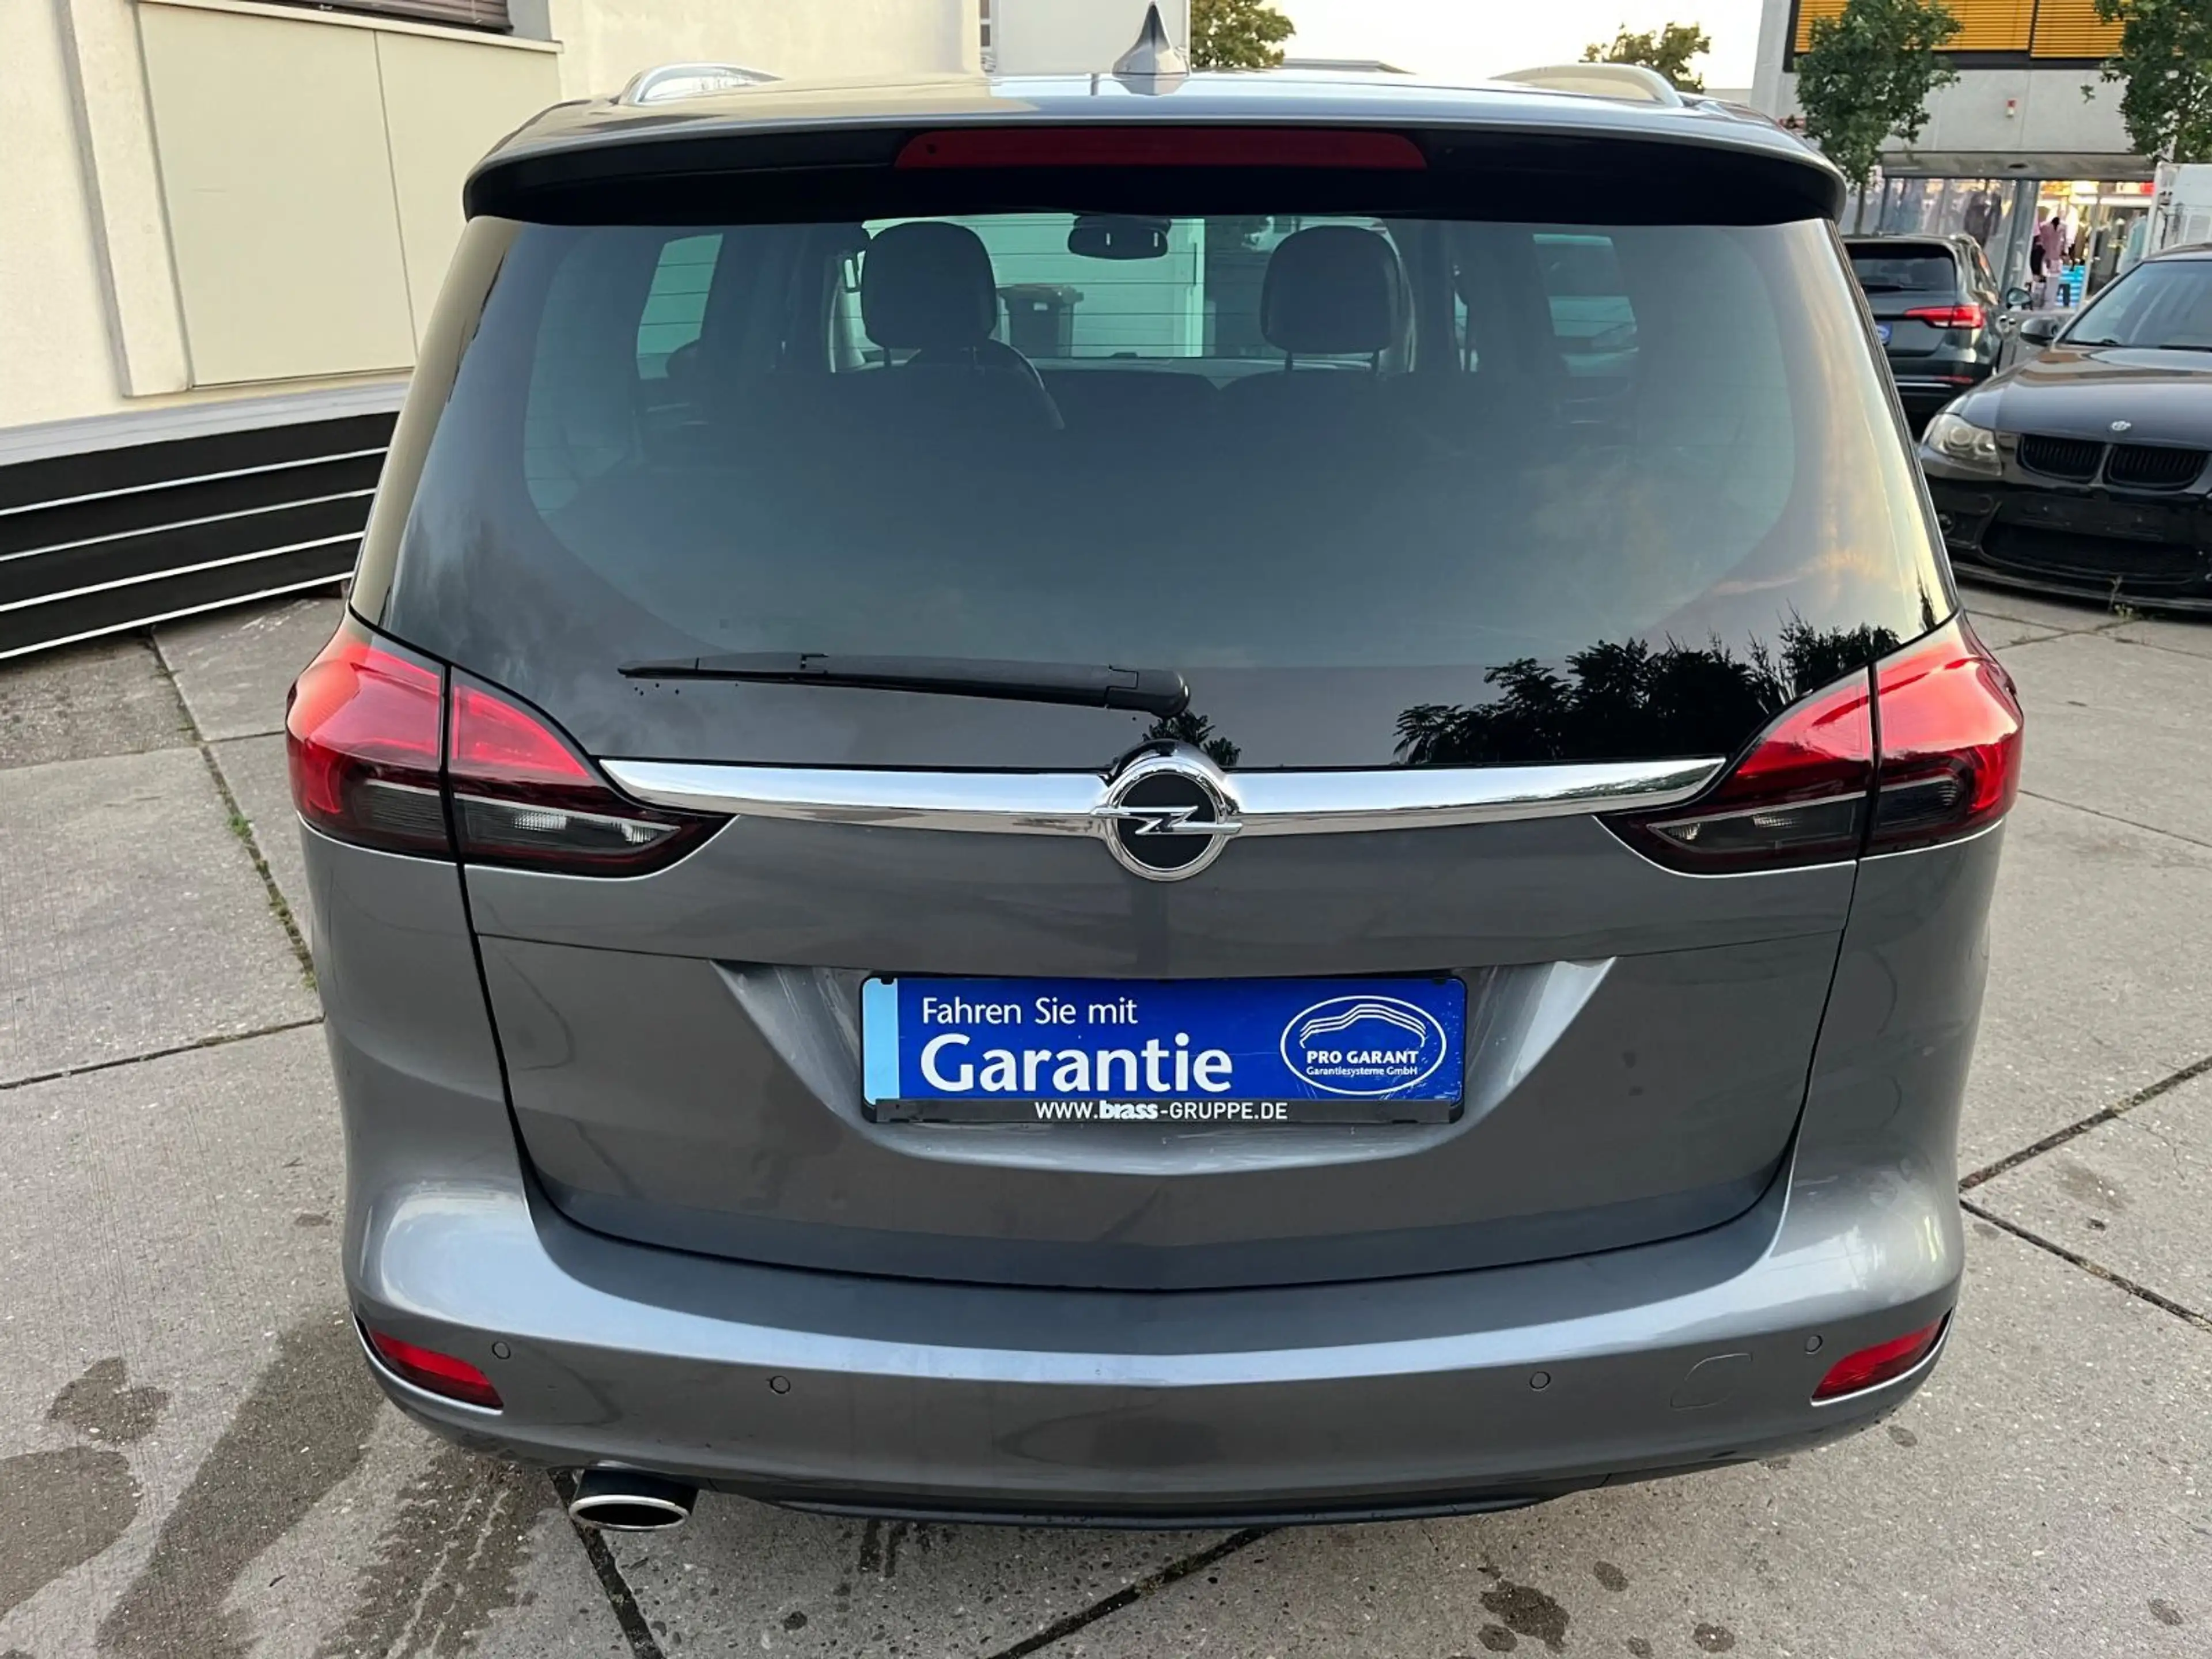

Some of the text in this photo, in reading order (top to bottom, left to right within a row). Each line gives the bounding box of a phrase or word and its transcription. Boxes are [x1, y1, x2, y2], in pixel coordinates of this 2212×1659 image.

[923, 996, 1139, 1025] Fahren Sie mit
[921, 1032, 1233, 1093] Garantie
[1306, 1050, 1419, 1064] PRO GARANT
[1306, 1066, 1418, 1077] Garantiesysteme GmbH
[1035, 1100, 1288, 1120] WWW.brass-GRUPPE.DE
